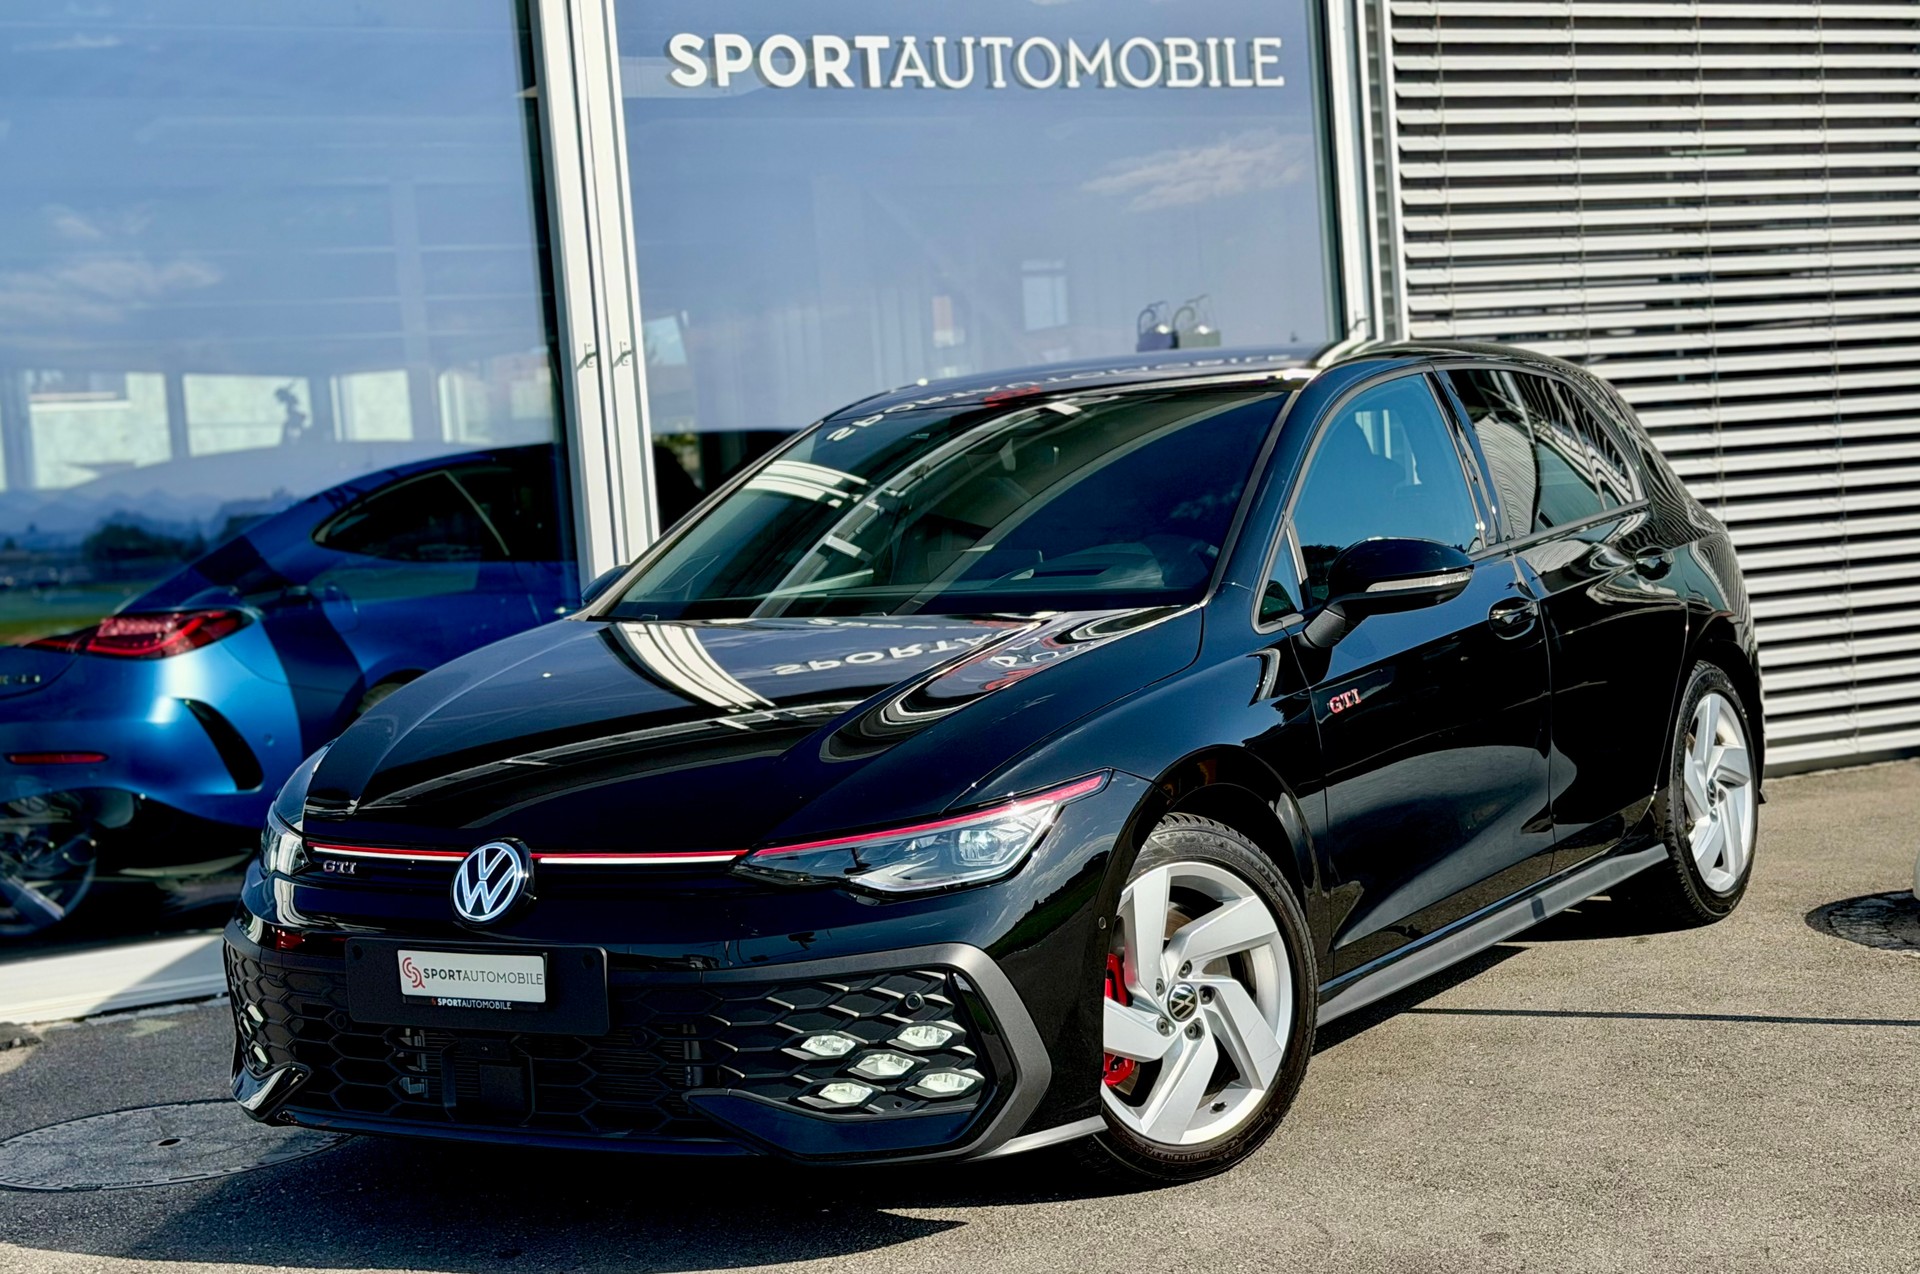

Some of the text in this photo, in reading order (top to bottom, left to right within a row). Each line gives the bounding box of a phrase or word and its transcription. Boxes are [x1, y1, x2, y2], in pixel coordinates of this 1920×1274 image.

[667, 33, 1285, 88] SPORTAUTOMOBILE
[1329, 688, 1362, 714] GTI
[322, 860, 357, 874] GTI
[423, 967, 544, 986] SPORTAUTOMOBILE
[437, 998, 512, 1010] SPORTAUTOMOBILE
